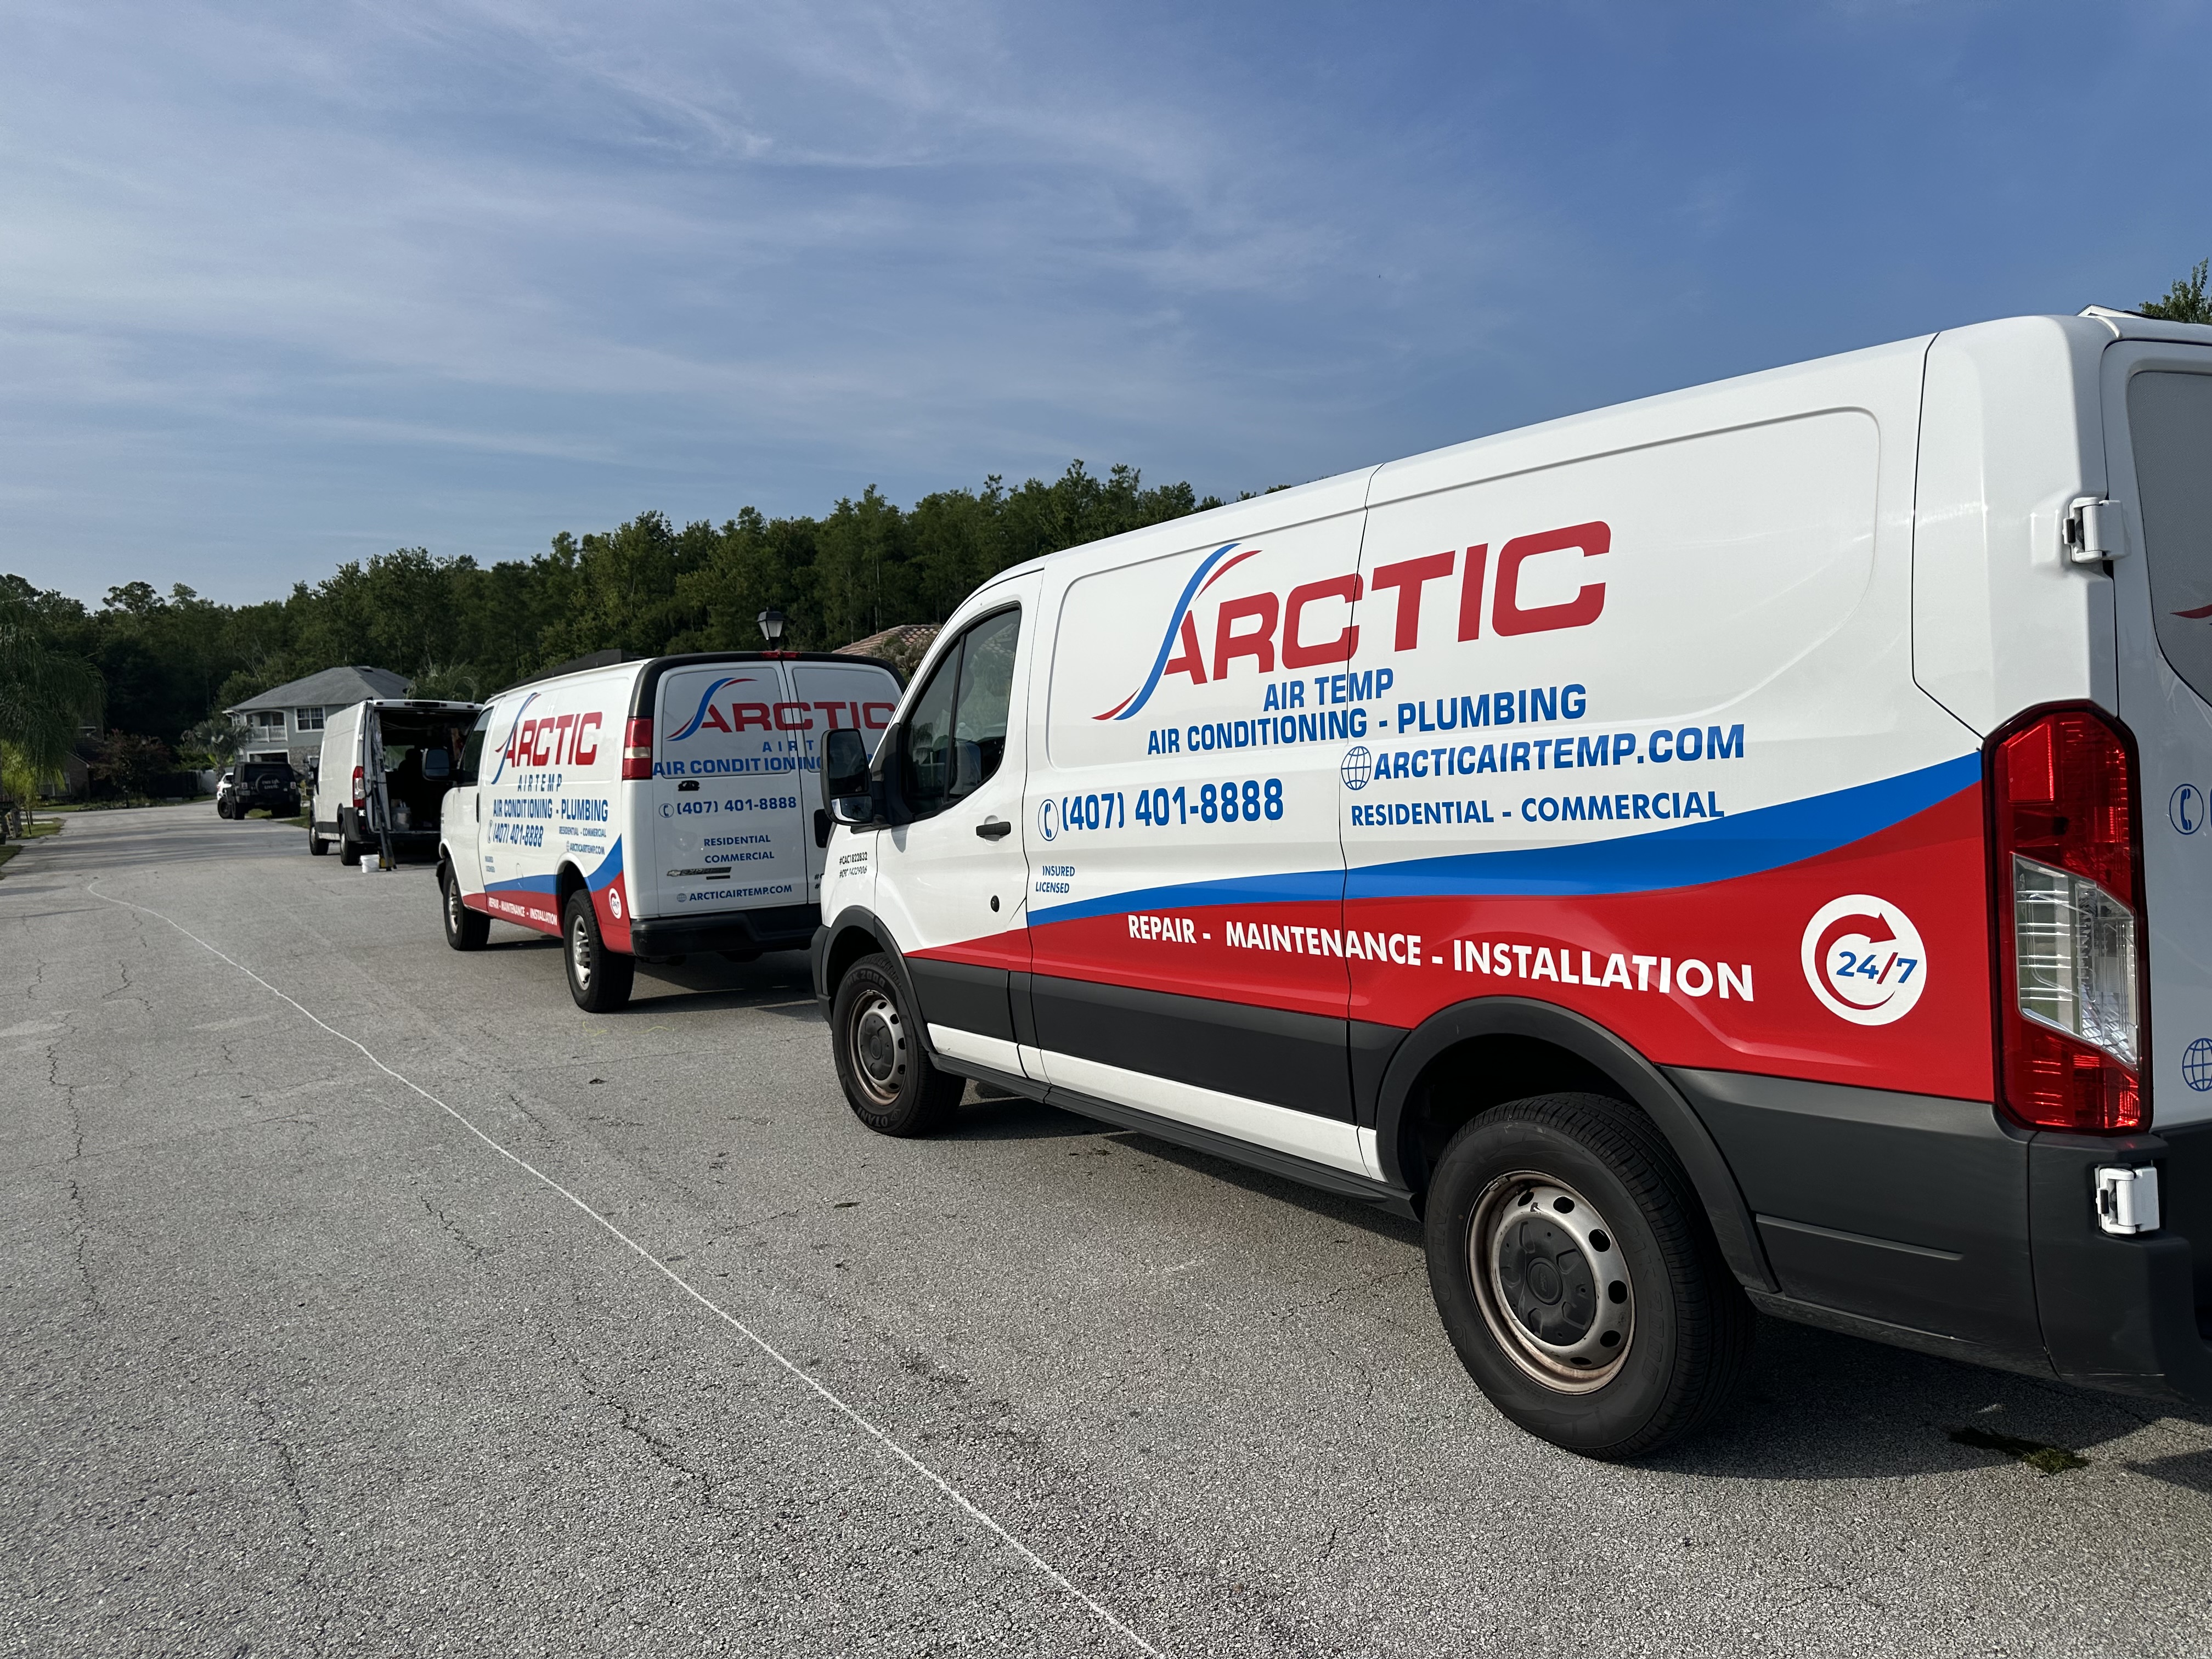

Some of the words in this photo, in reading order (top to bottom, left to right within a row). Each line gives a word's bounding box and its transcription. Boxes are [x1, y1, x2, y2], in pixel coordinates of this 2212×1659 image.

[1162, 521, 1611, 685] ARCTIC
[1263, 680, 1305, 712] AIR
[1314, 668, 1394, 705] TEMP
[700, 702, 895, 733] ARCTIC
[1148, 725, 1180, 755] AIR
[1187, 708, 1368, 752] CONDITIONING
[1378, 719, 1388, 729] -
[1397, 683, 1587, 734] PLUMBING
[505, 712, 602, 768] ARCTIC
[1373, 724, 1745, 781] ARCTICAIRTEMP.COM
[653, 761, 685, 776] AIR
[493, 799, 502, 817] AIR
[504, 798, 552, 818] CONDITIONING
[561, 799, 608, 821] PLUMBING
[676, 800, 719, 815] (407)
[724, 796, 797, 812] 401-8888
[1062, 791, 1125, 832] (407)
[1135, 777, 1284, 827] 401-8888
[1351, 800, 1494, 827] RESIDENTIAL
[1521, 791, 1725, 823] COMMERCIAL
[510, 823, 544, 847] 401-8888
[704, 834, 771, 847] RESIDENTIAL
[704, 851, 775, 864] COMMERCIAL
[1042, 865, 1076, 878] INSURED
[689, 884, 793, 901] ARCTICAIRTEMP.COM
[1035, 881, 1070, 894] LICENSED
[530, 907, 557, 926] INSTALLATION
[1127, 914, 1198, 944] REPAIR
[1226, 921, 1421, 966] MAINTENANCE
[1431, 955, 1444, 965] -
[1453, 939, 1754, 1002] INSTALLATION
[1836, 950, 1918, 985] 24/7
[861, 969, 886, 988] 2000
[856, 1106, 889, 1128] OTANI
